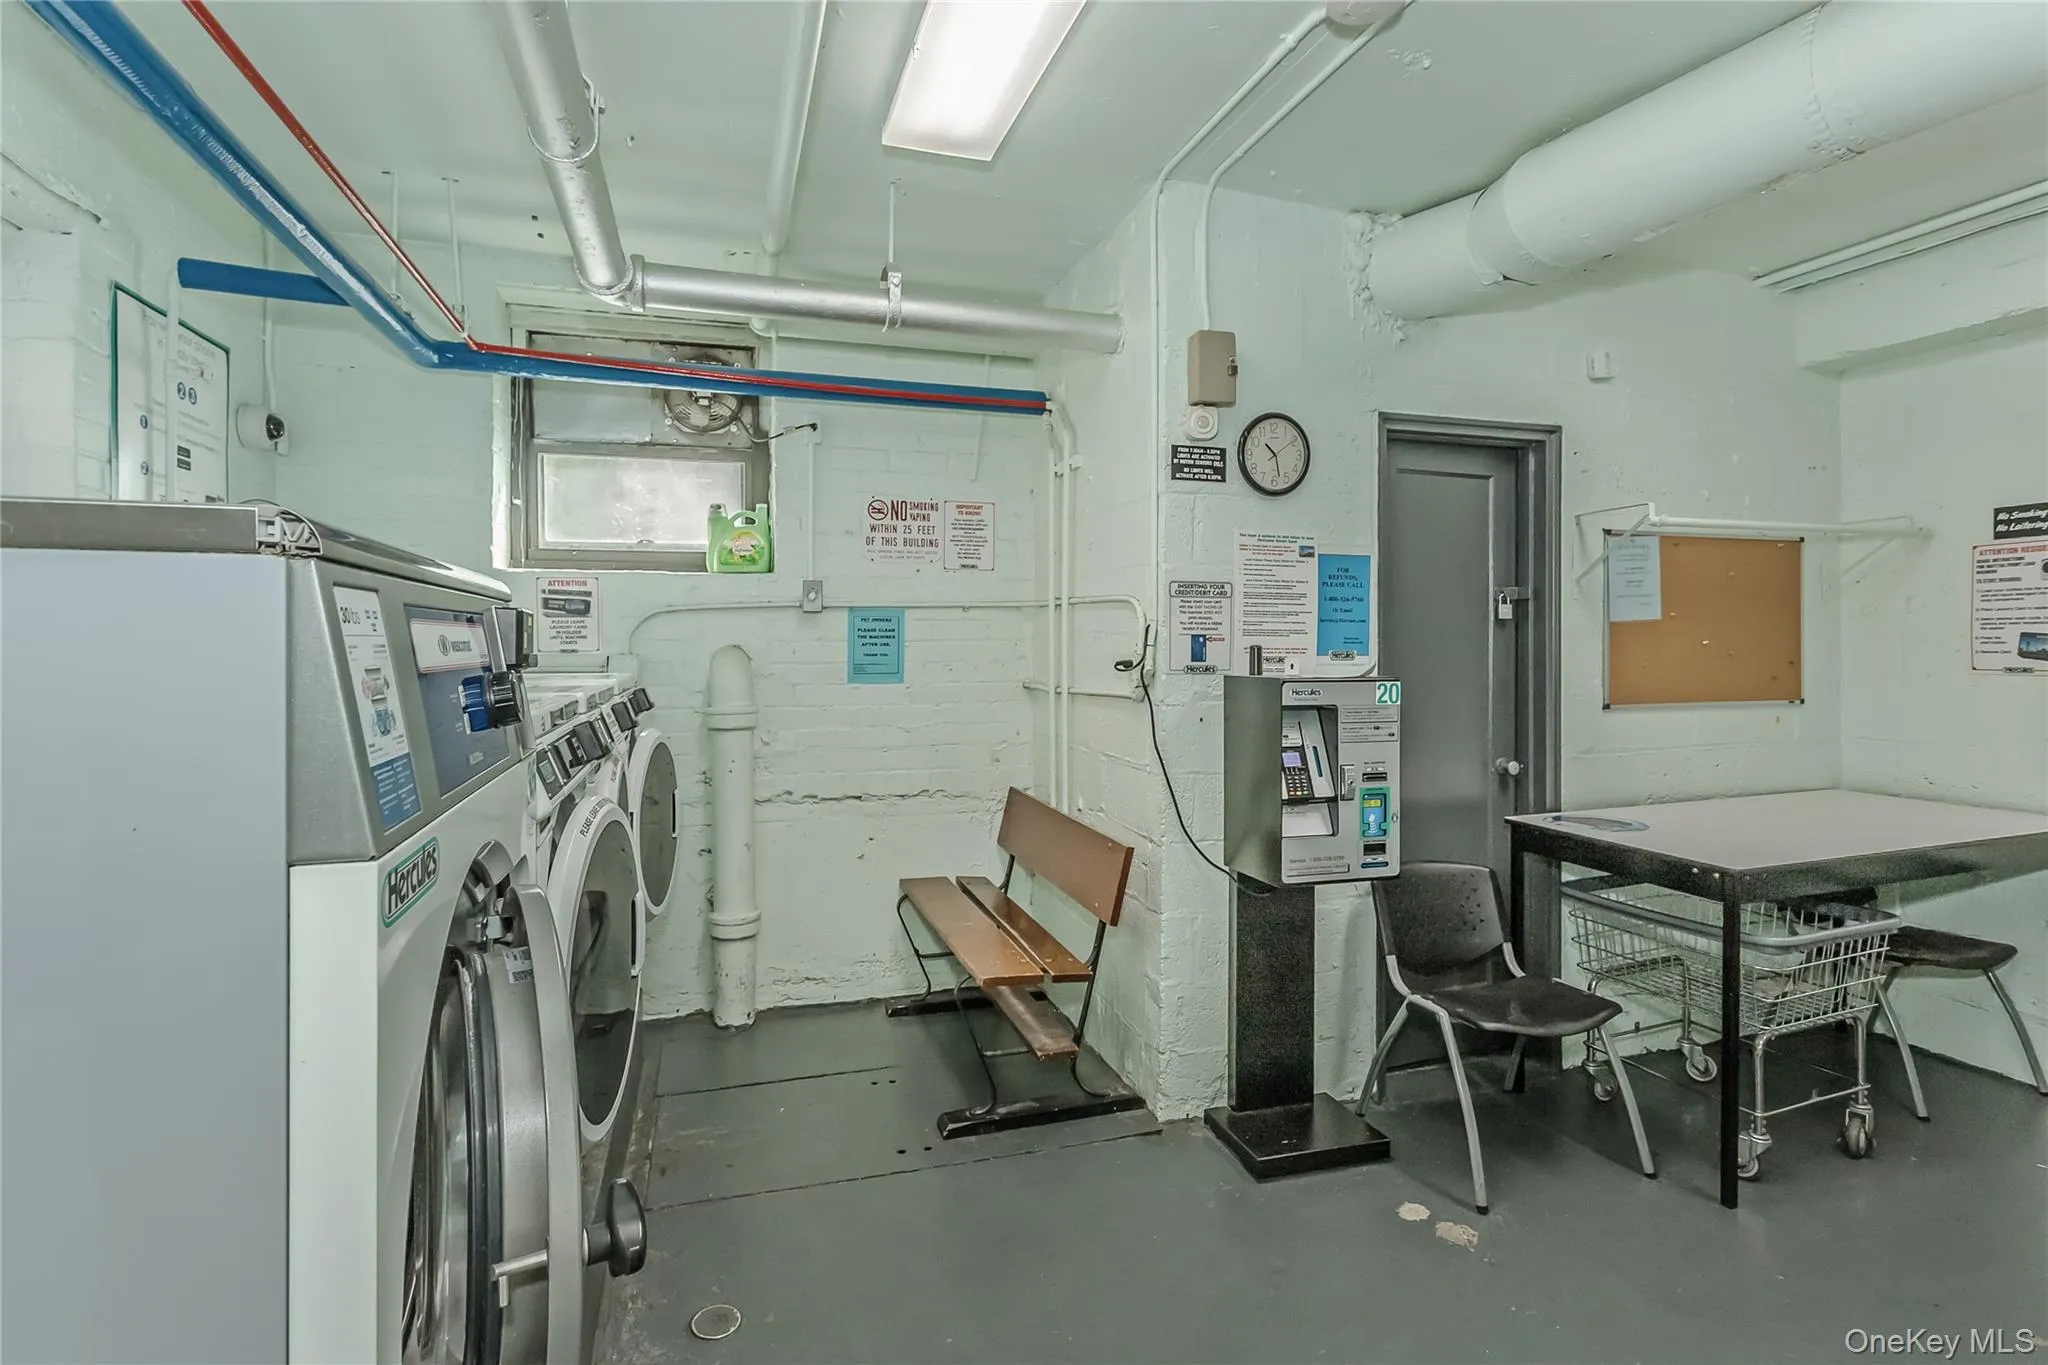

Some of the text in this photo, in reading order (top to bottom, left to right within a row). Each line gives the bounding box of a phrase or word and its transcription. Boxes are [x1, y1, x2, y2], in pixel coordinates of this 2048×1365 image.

[1246, 449, 1252, 460] 9
[1251, 463, 1257, 474] 8
[1260, 472, 1265, 482] 7
[1271, 476, 1278, 487] 6
[1283, 472, 1289, 483] 5
[891, 500, 938, 521] NO SMOKING
[1996, 509, 2048, 520] No Smoking
[909, 512, 930, 522] VAPING
[869, 523, 935, 535] WITHIN 25 FEET
[1996, 521, 2048, 532] No Loitering
[865, 536, 939, 548] OF THIS BUILDING
[1980, 547, 2018, 556] ATTENTION
[340, 607, 351, 623] 30
[1262, 656, 1286, 664] Hercule
[1186, 665, 1215, 673] Hercules
[1291, 689, 1321, 697] Hercules
[1377, 683, 1400, 704] 20
[388, 846, 437, 915] Hercules
